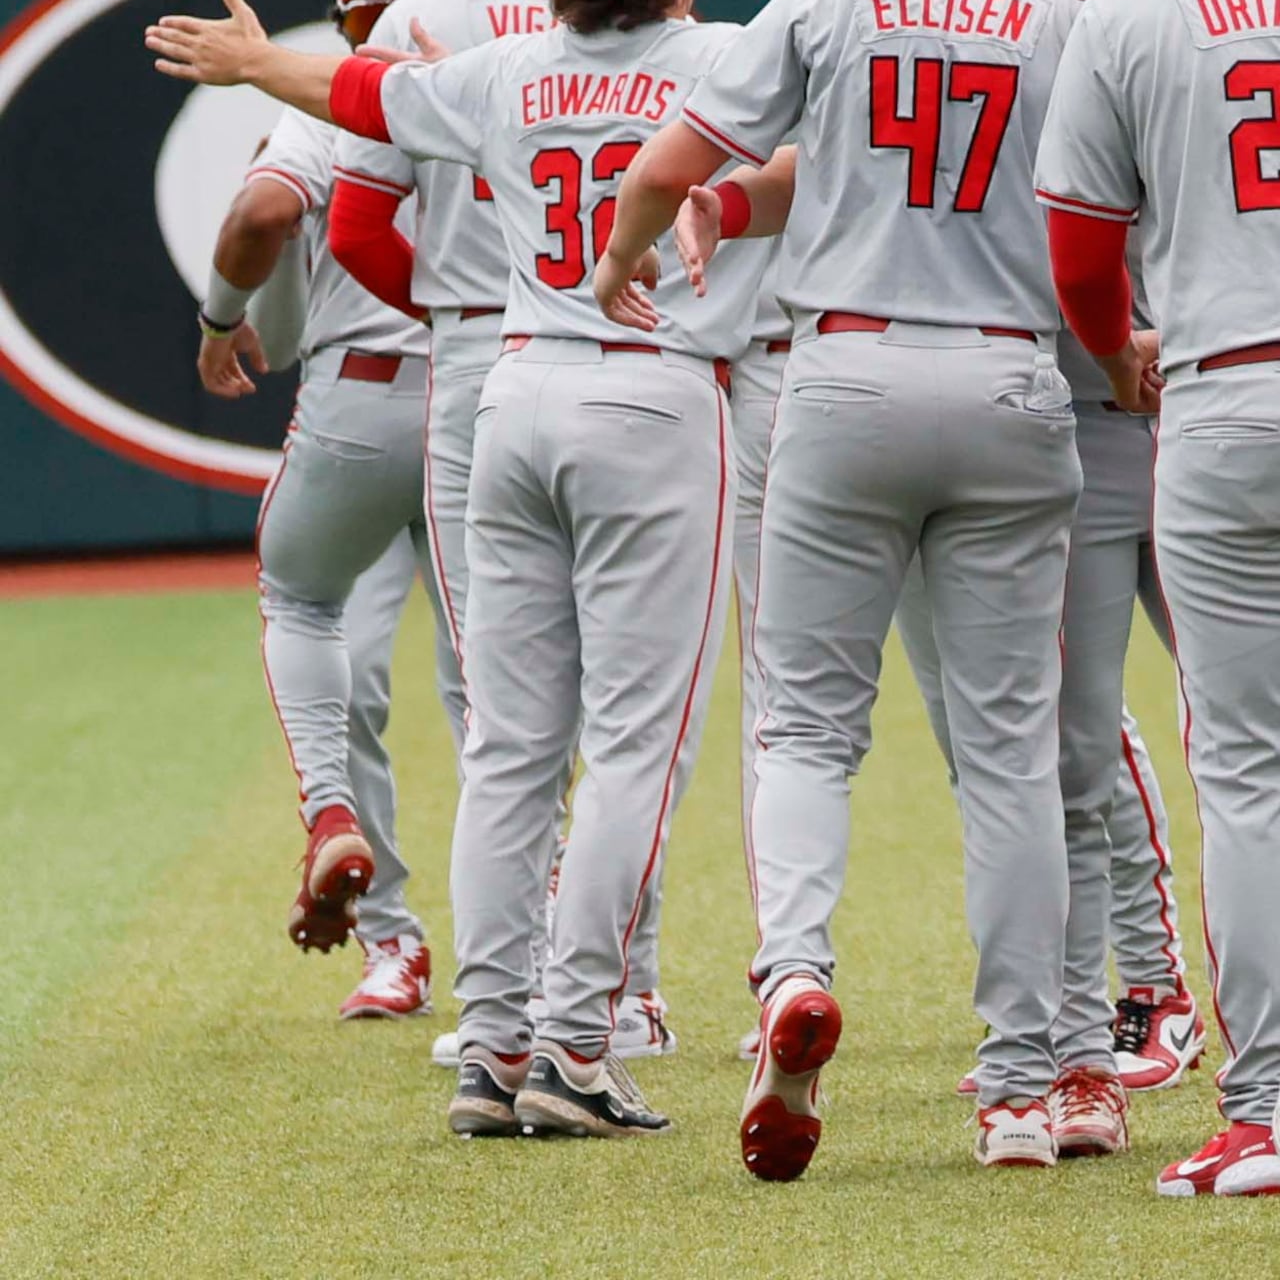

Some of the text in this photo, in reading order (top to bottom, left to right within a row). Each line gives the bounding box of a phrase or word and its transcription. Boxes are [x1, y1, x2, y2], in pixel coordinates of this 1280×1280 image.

[487, 4, 557, 39] VIG
[521, 72, 677, 126] EDWARDS
[870, 56, 1020, 213] 47
